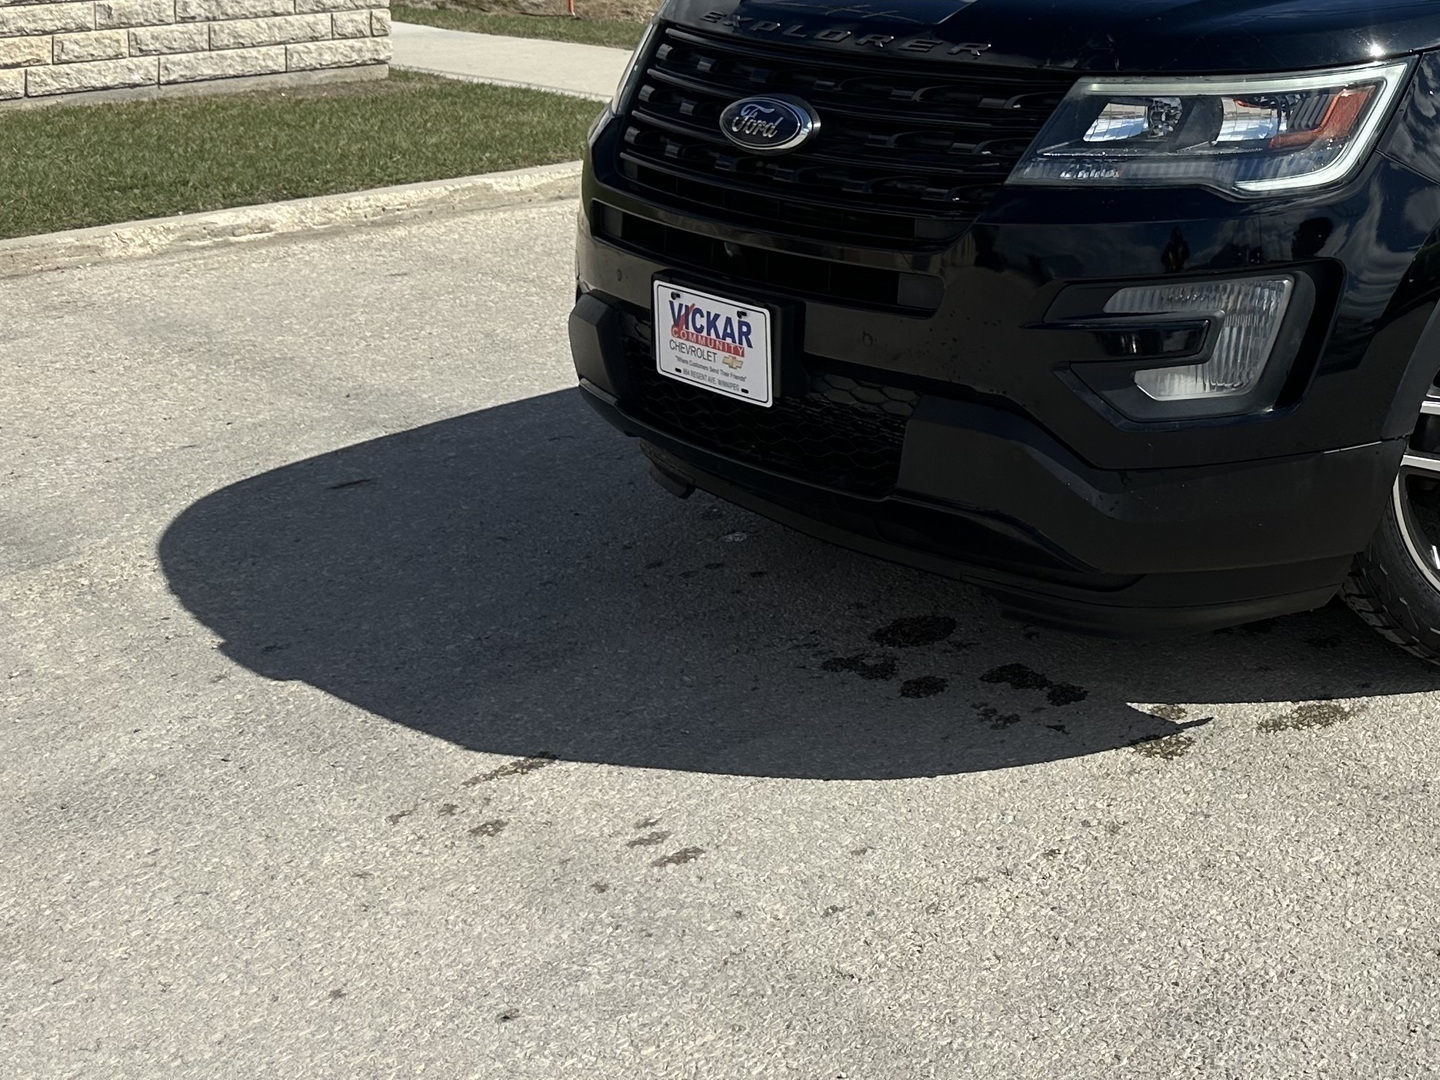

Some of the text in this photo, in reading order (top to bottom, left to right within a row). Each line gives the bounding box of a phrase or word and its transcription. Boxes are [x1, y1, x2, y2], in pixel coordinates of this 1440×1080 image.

[700, 11, 992, 57] EXPLORER
[732, 103, 784, 138] Ford
[669, 300, 753, 349] VICKAR
[672, 327, 744, 355] COMMUNITY
[669, 339, 717, 364] CHEVROLET
